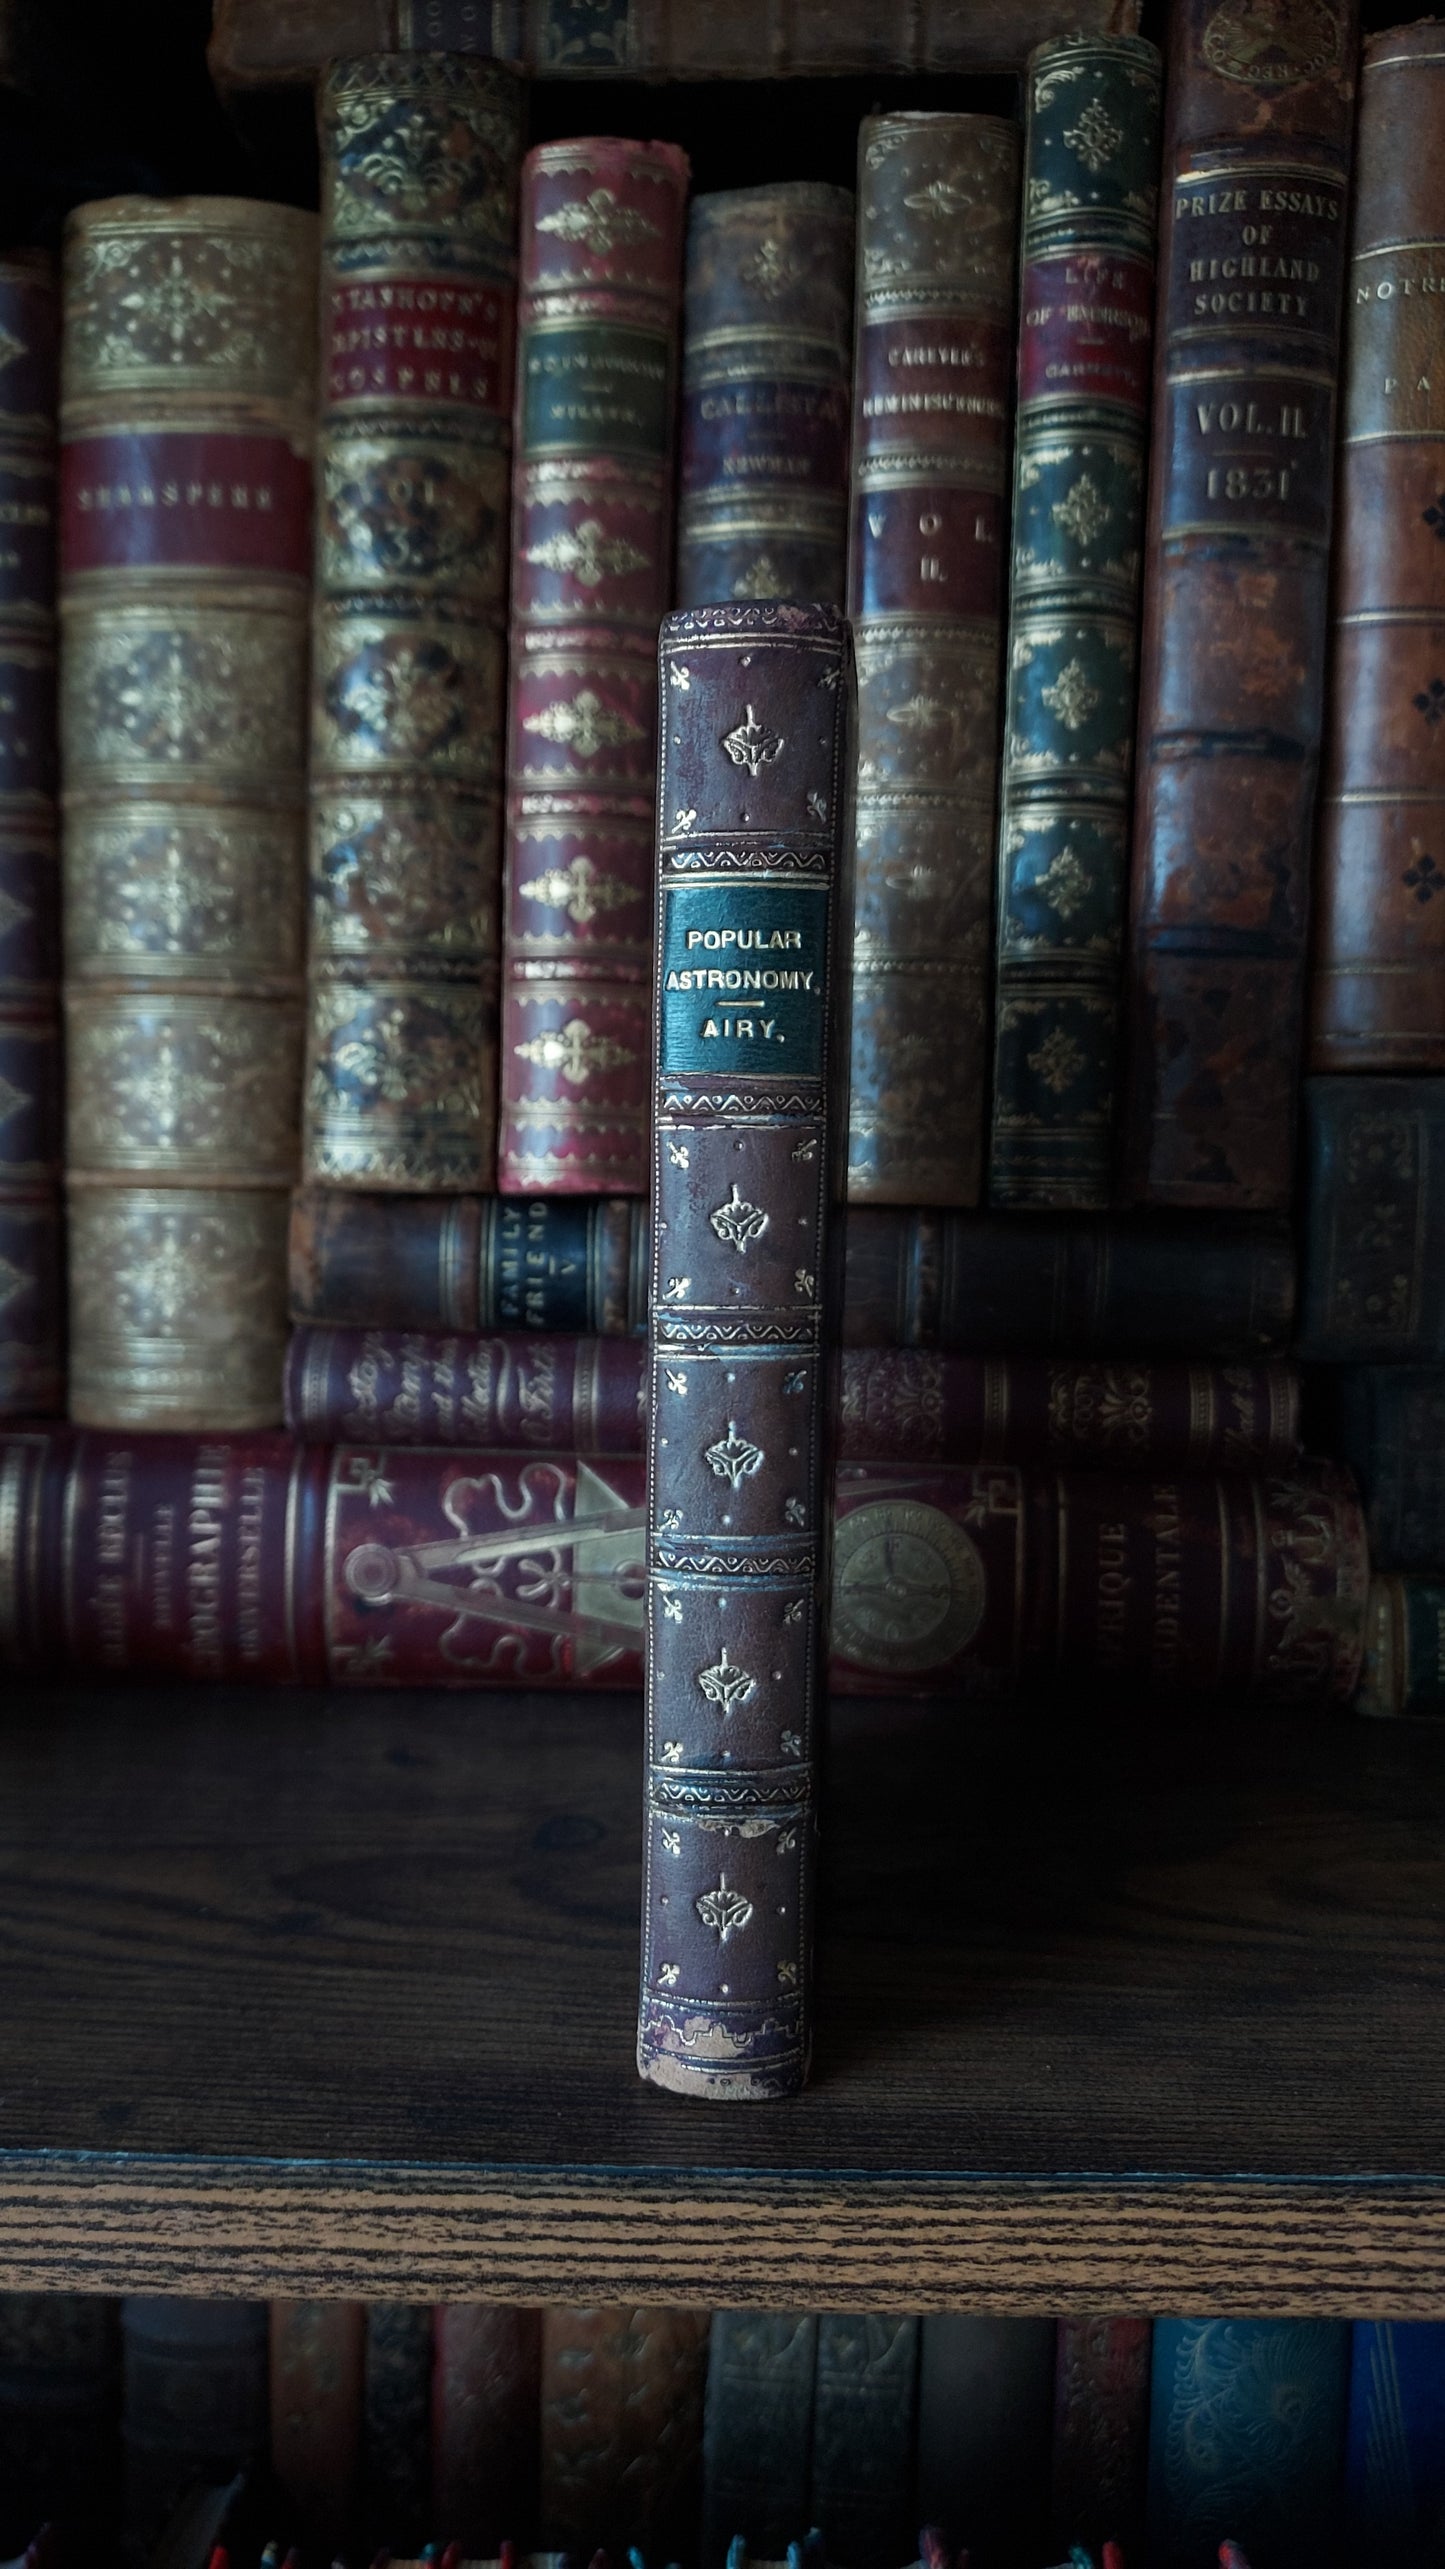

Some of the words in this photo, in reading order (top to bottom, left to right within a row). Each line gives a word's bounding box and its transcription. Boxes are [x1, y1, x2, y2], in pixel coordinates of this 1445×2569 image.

[1175, 189, 1248, 219] PRIZE
[1260, 189, 1339, 221] ESSAYS
[1242, 224, 1273, 246] OF
[1189, 256, 1321, 283] HIGHLAND
[1026, 305, 1053, 328] OF
[1193, 291, 1310, 317] SOCIETY
[888, 342, 986, 368] CARLYLE'S
[1197, 402, 1274, 434] VOL.
[687, 929, 802, 950] POPULAR
[501, 1206, 523, 1317] FAMILY
[526, 1201, 549, 1326] FRIEND
